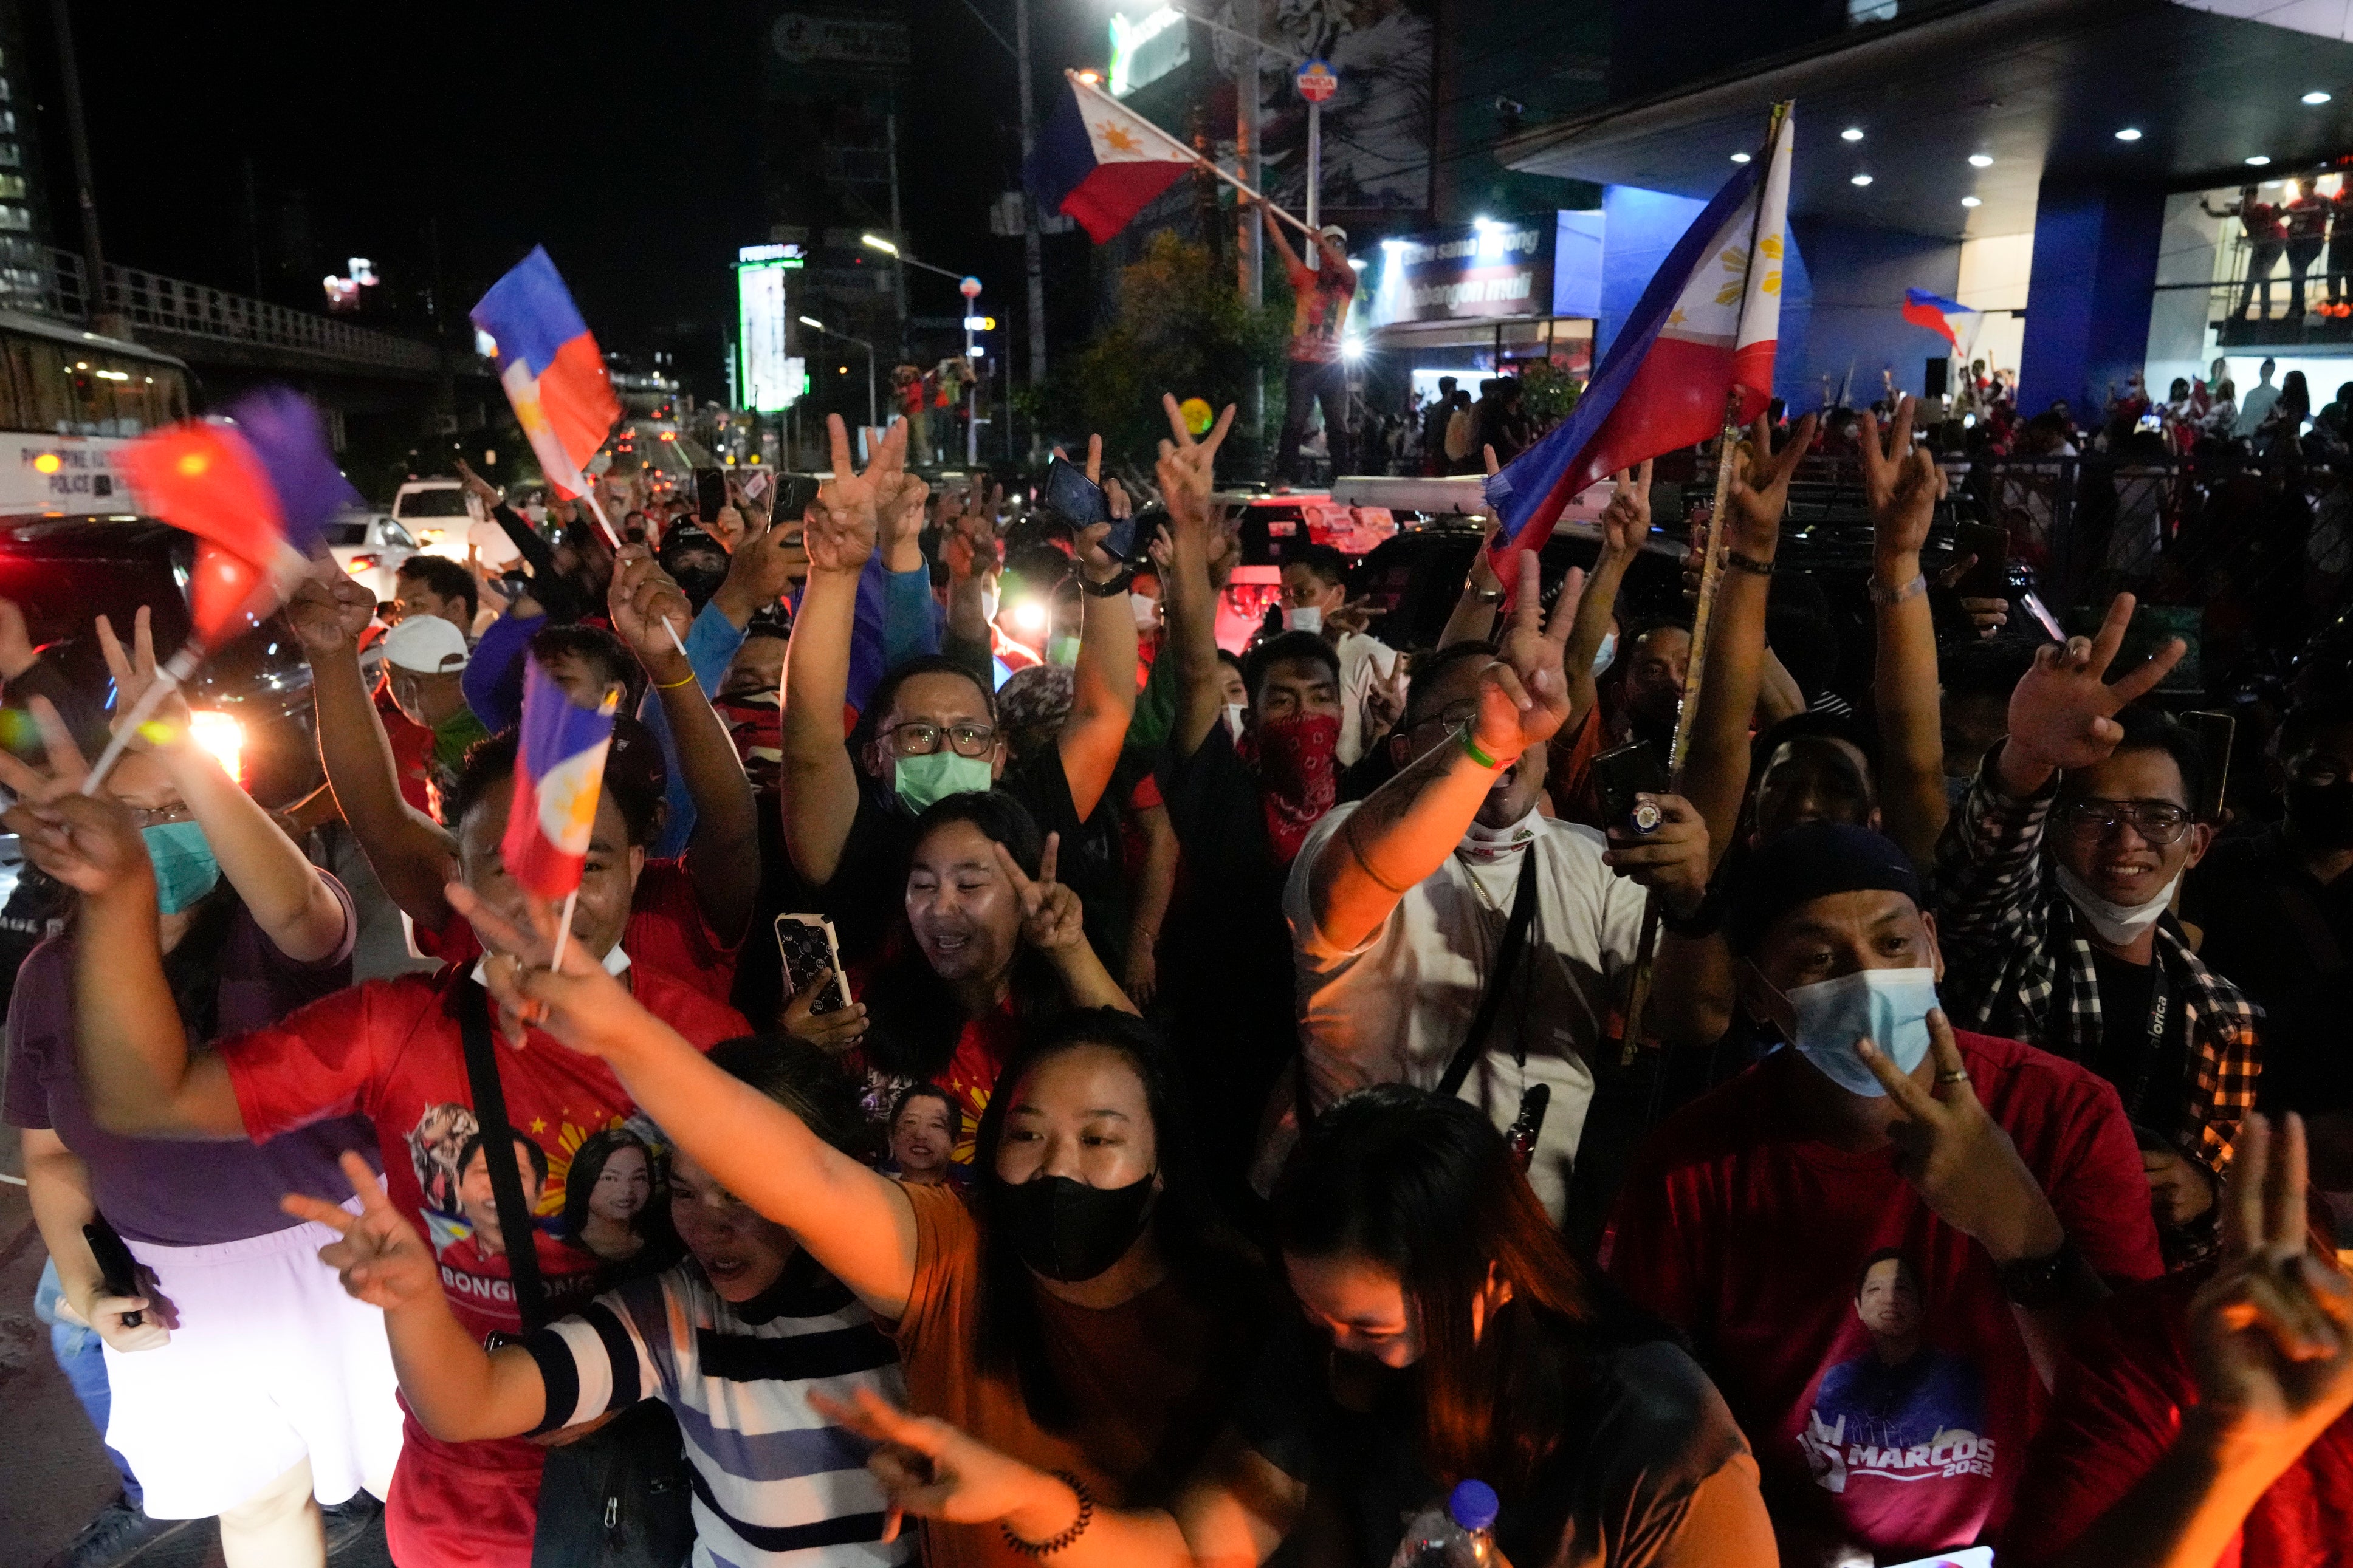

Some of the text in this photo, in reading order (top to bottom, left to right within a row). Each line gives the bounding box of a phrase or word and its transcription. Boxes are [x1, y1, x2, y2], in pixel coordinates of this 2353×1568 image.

[2147, 995, 2168, 1050] alorica
[1847, 1436, 1996, 1469] MARCOS
[1942, 1459, 1994, 1479] 2022
